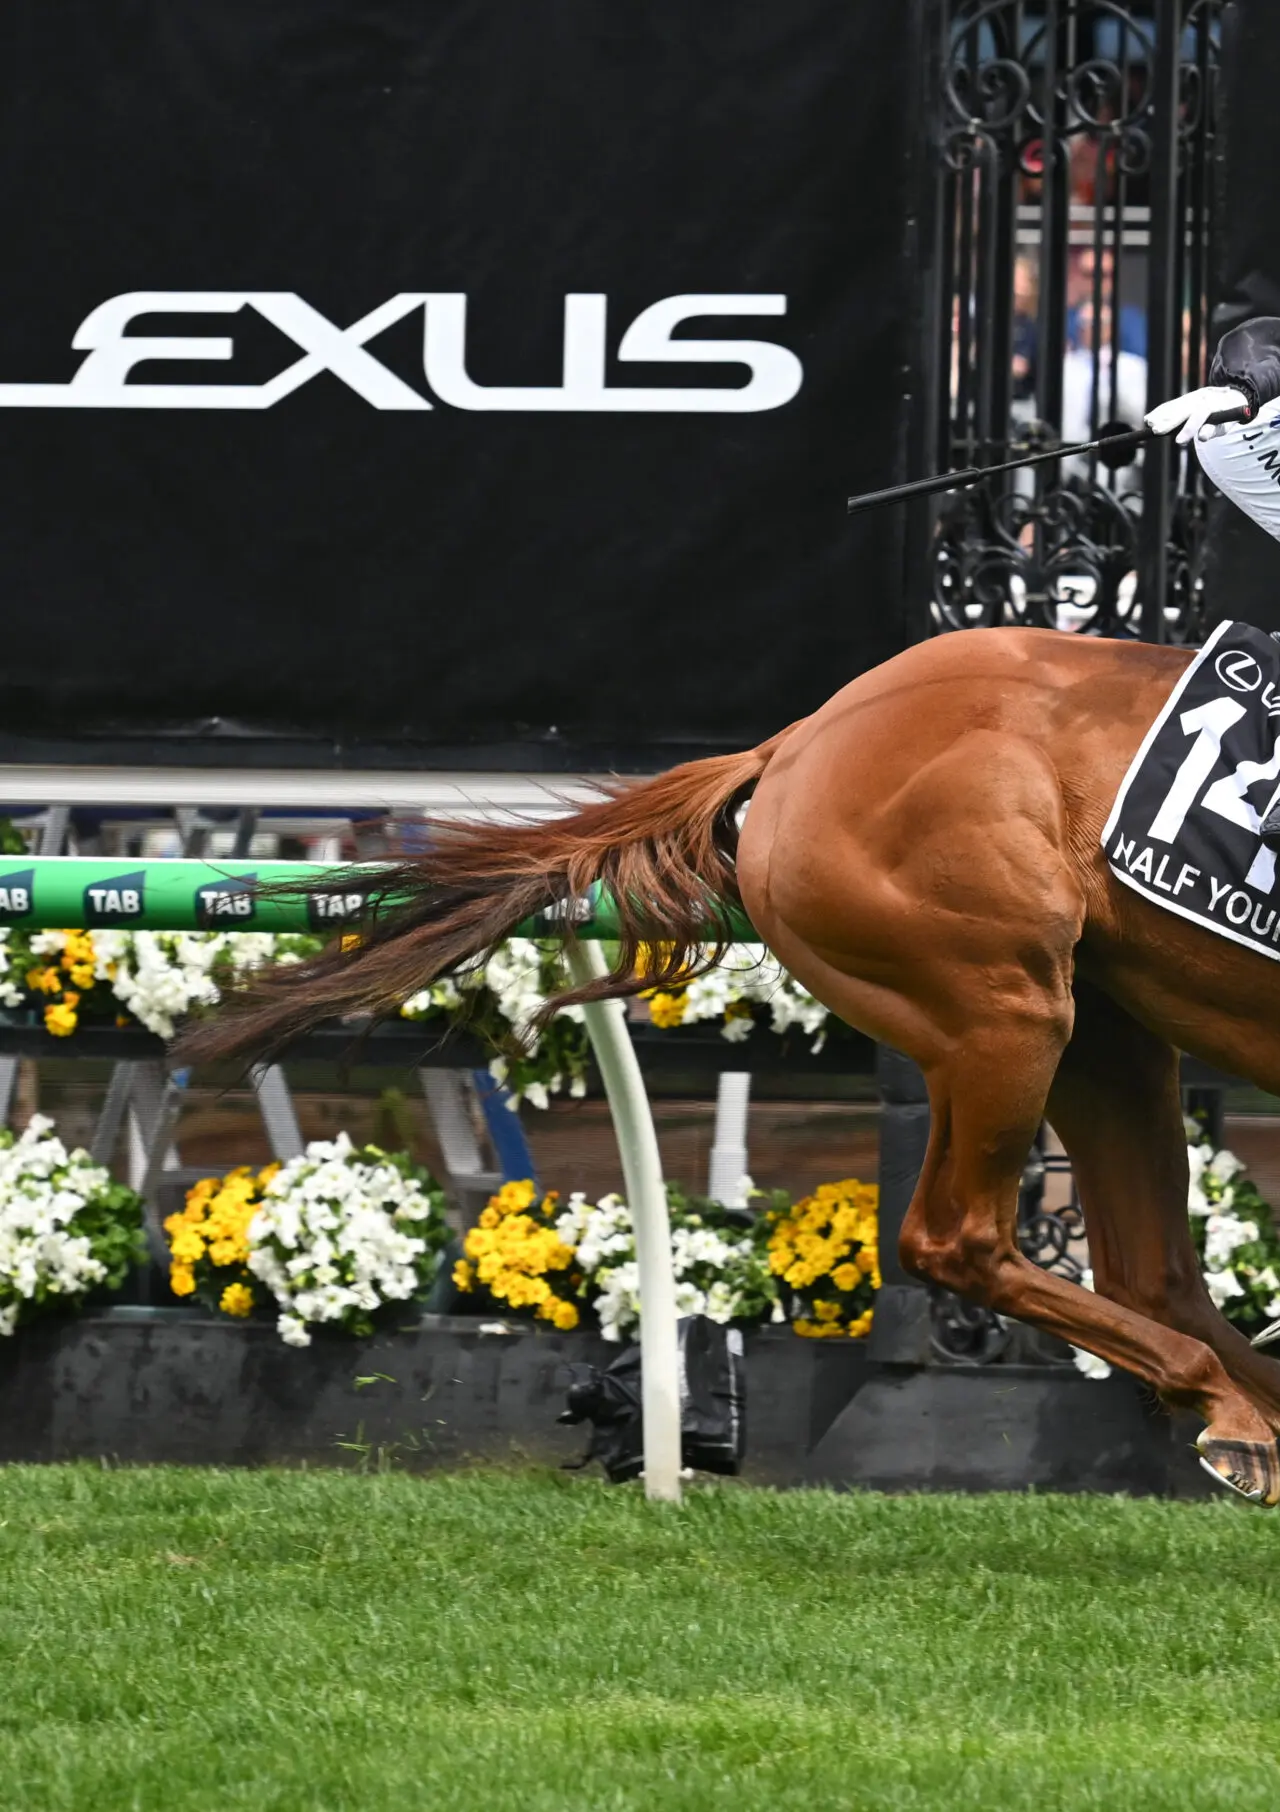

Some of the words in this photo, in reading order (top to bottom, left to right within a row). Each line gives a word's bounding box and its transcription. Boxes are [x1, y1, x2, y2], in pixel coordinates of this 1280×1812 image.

[0, 291, 803, 412] EXUS
[1242, 431, 1264, 451] J.
[0, 888, 29, 911] AB
[88, 889, 140, 913] TAB
[201, 891, 252, 915] TAB
